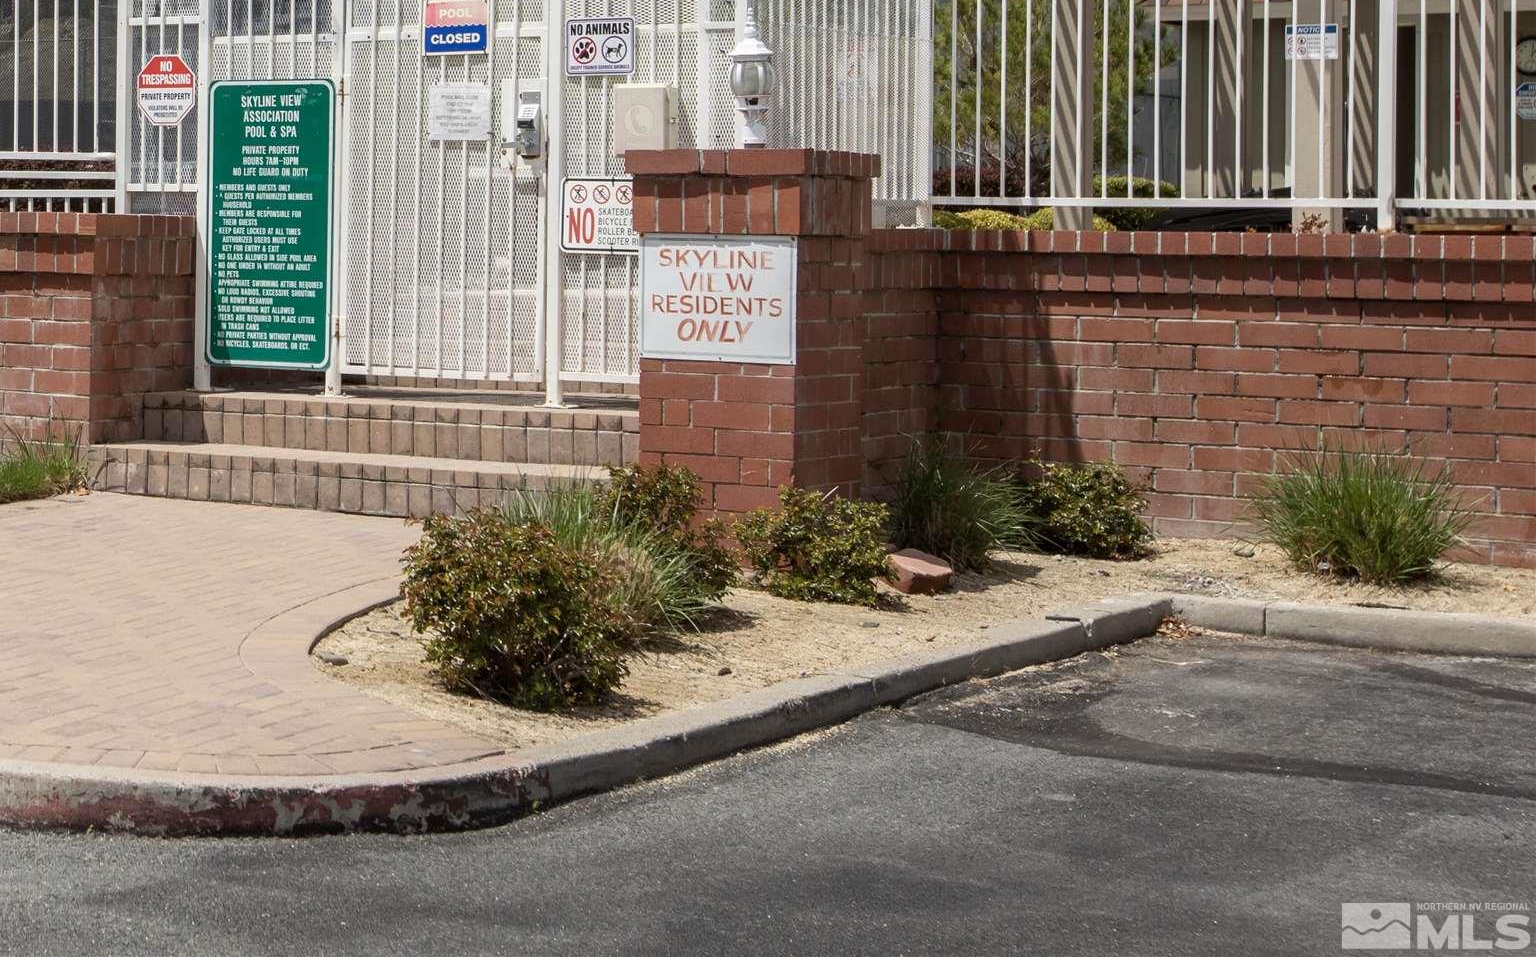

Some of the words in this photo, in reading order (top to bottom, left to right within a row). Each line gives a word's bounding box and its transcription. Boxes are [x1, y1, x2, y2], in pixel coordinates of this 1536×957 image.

[440, 9, 472, 18] POOL
[571, 24, 583, 36] NO
[586, 23, 629, 35] ANIMALS
[431, 33, 480, 44] CLOSED
[160, 61, 172, 71] NO
[142, 73, 191, 85] TRESPASSING
[241, 95, 276, 107] SKYLINE
[281, 95, 301, 106] VIEW
[244, 111, 299, 122] ASSOCIATION
[245, 126, 266, 137] POOL
[270, 126, 276, 137] &
[281, 126, 297, 137] SPA
[242, 146, 266, 154] PRIVATE
[269, 146, 299, 154] PROPERTY
[243, 157, 263, 165] HOURS
[233, 168, 241, 176] NO
[244, 168, 256, 176] LIFE
[259, 168, 279, 176] GUARD
[282, 168, 290, 176] ON
[293, 168, 308, 176] DUTY
[257, 210, 290, 218] RESPONSIBLE
[568, 208, 594, 244] NO
[598, 227, 624, 235] ROLLER
[597, 237, 629, 245] SCOOTER
[659, 248, 775, 270] SKYLINE
[299, 281, 323, 289] REQUIRED
[679, 272, 753, 292] VIEW
[263, 289, 289, 297] EXCESSIVE
[652, 294, 782, 317] RESIDENTS
[247, 315, 271, 323] REQUIRED
[298, 316, 315, 324] LITTER
[677, 318, 753, 342] ONLY
[226, 331, 245, 339] PRIVATE
[247, 332, 267, 340] PARTIES
